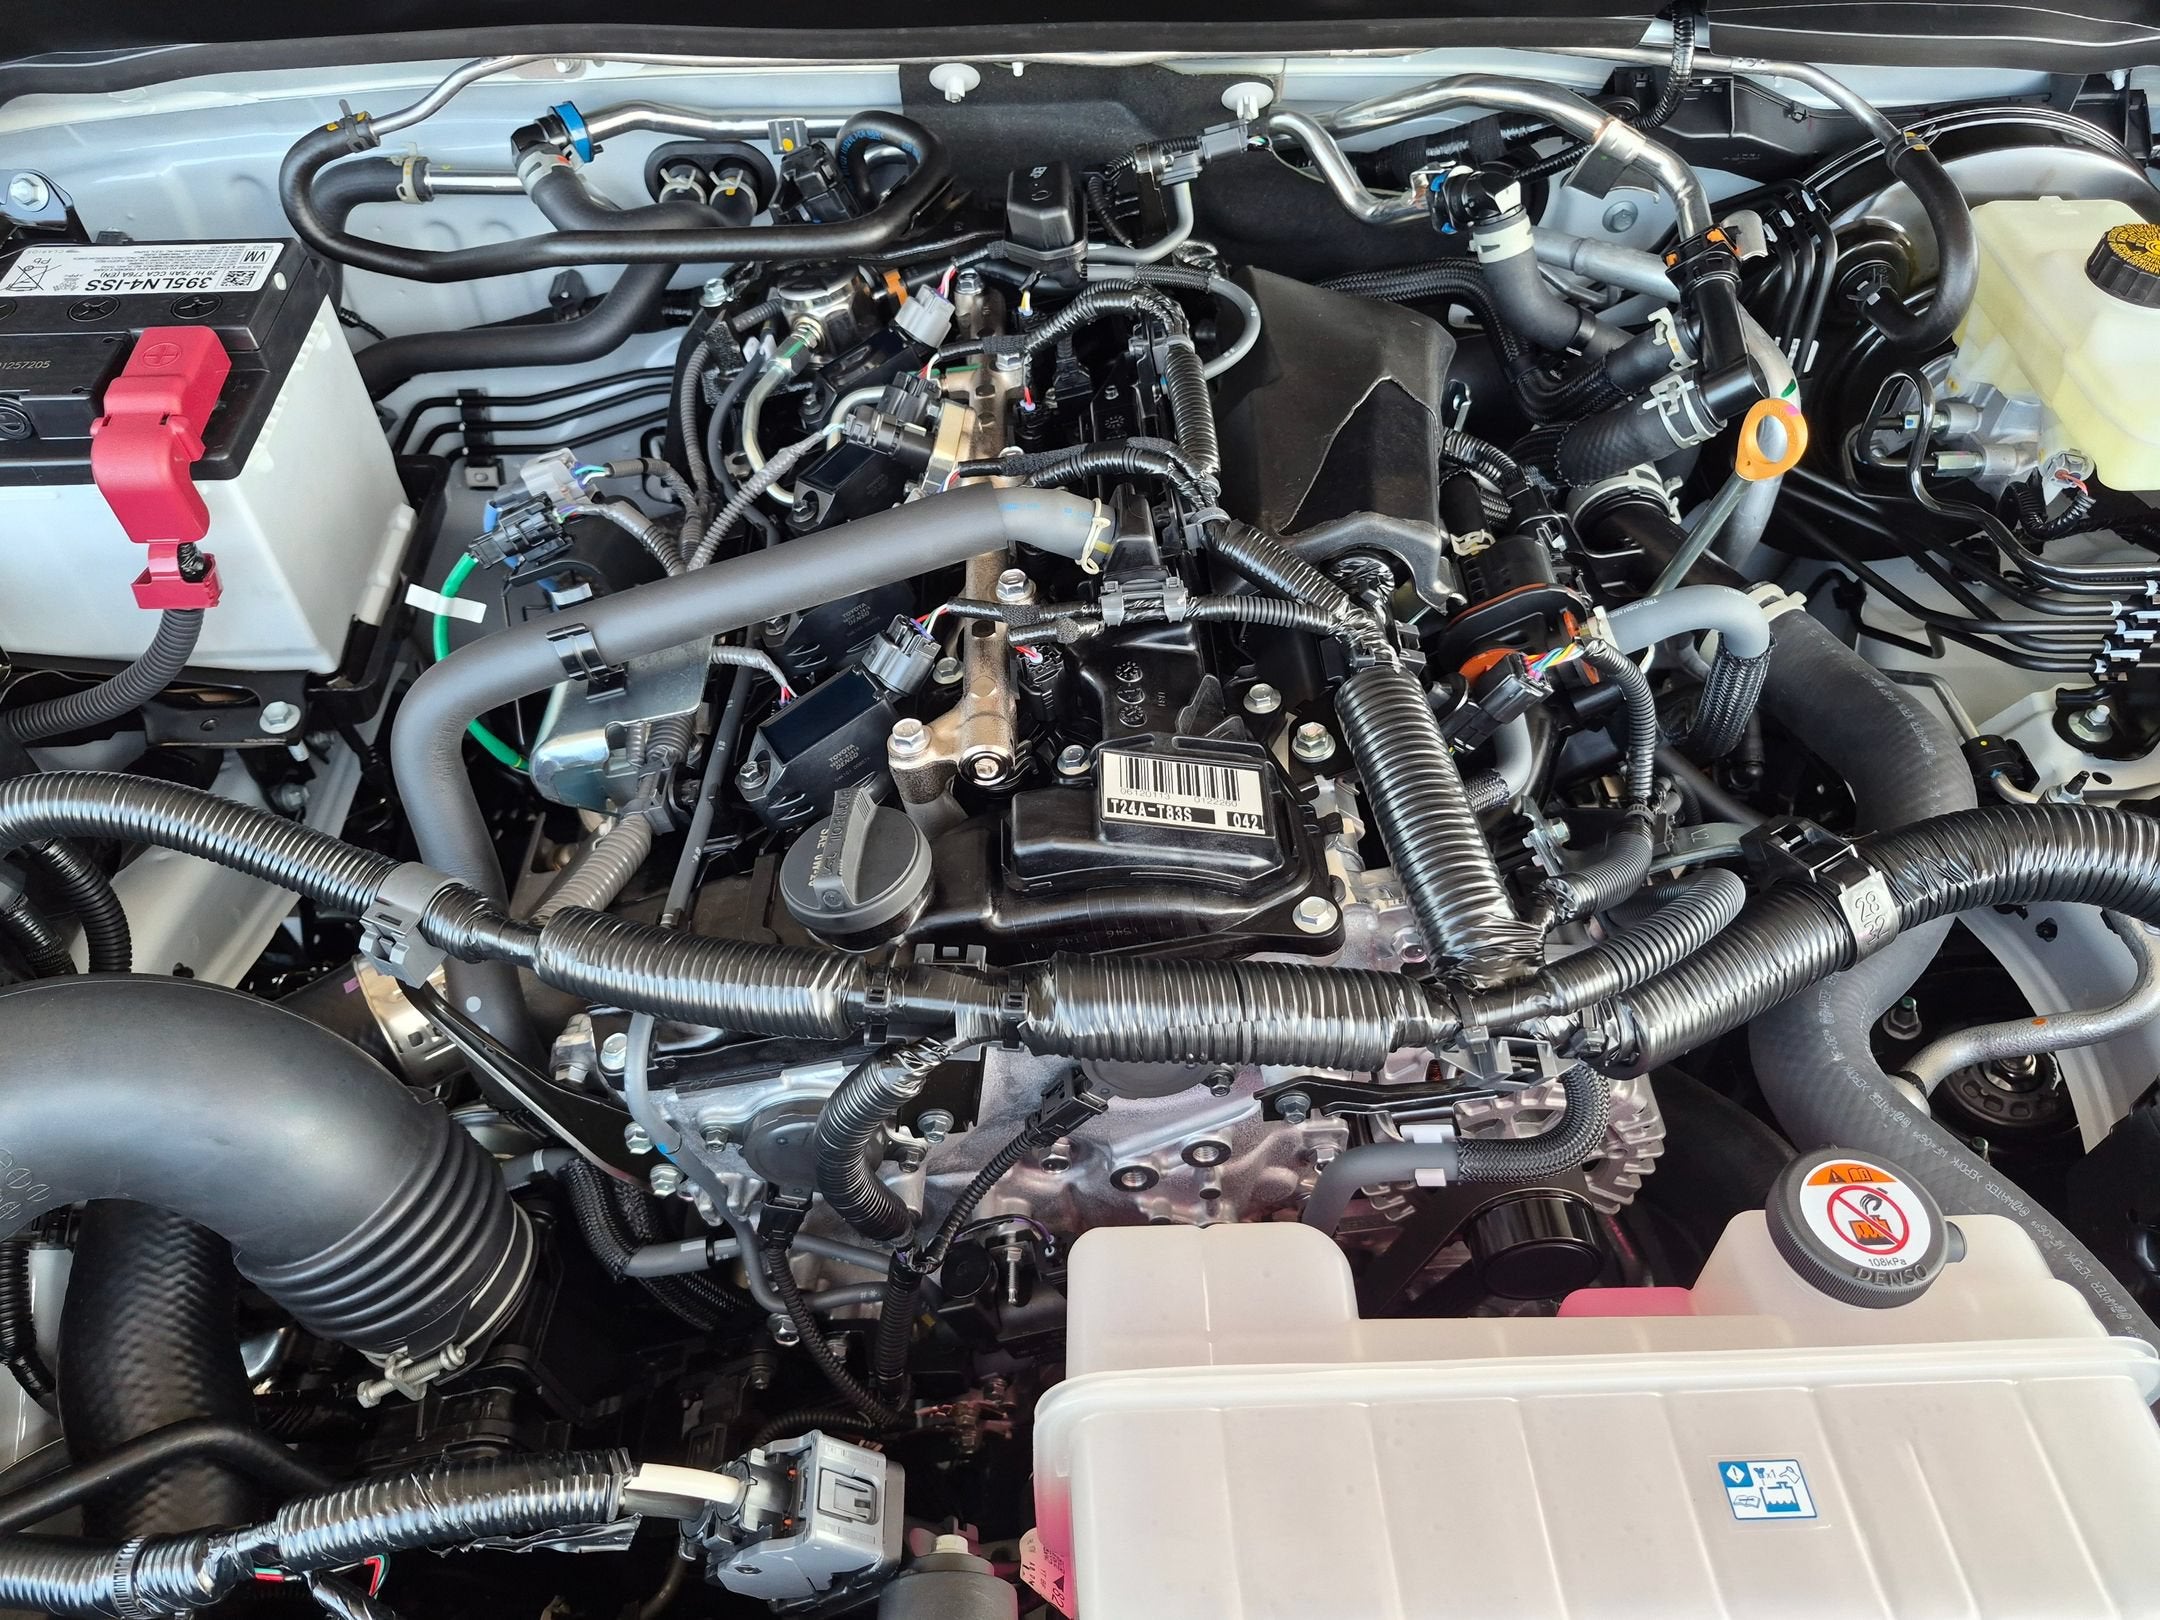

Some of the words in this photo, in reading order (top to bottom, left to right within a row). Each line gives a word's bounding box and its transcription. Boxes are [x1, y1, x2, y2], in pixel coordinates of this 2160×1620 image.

[243, 250, 267, 262] VM
[85, 277, 213, 291] 395LN4-ISS
[0, 360, 51, 370] 1257205
[829, 744, 856, 762] TOYOTA
[835, 752, 858, 770] DENSO
[1120, 788, 1171, 800] 06120113
[1194, 796, 1238, 808] 0122260
[1110, 799, 1193, 822] T24A-T83S
[1232, 813, 1259, 830] 042
[1855, 891, 1881, 922] 28
[1868, 1257, 1907, 1267] 108kPa
[1855, 1263, 1928, 1287] DENSO
